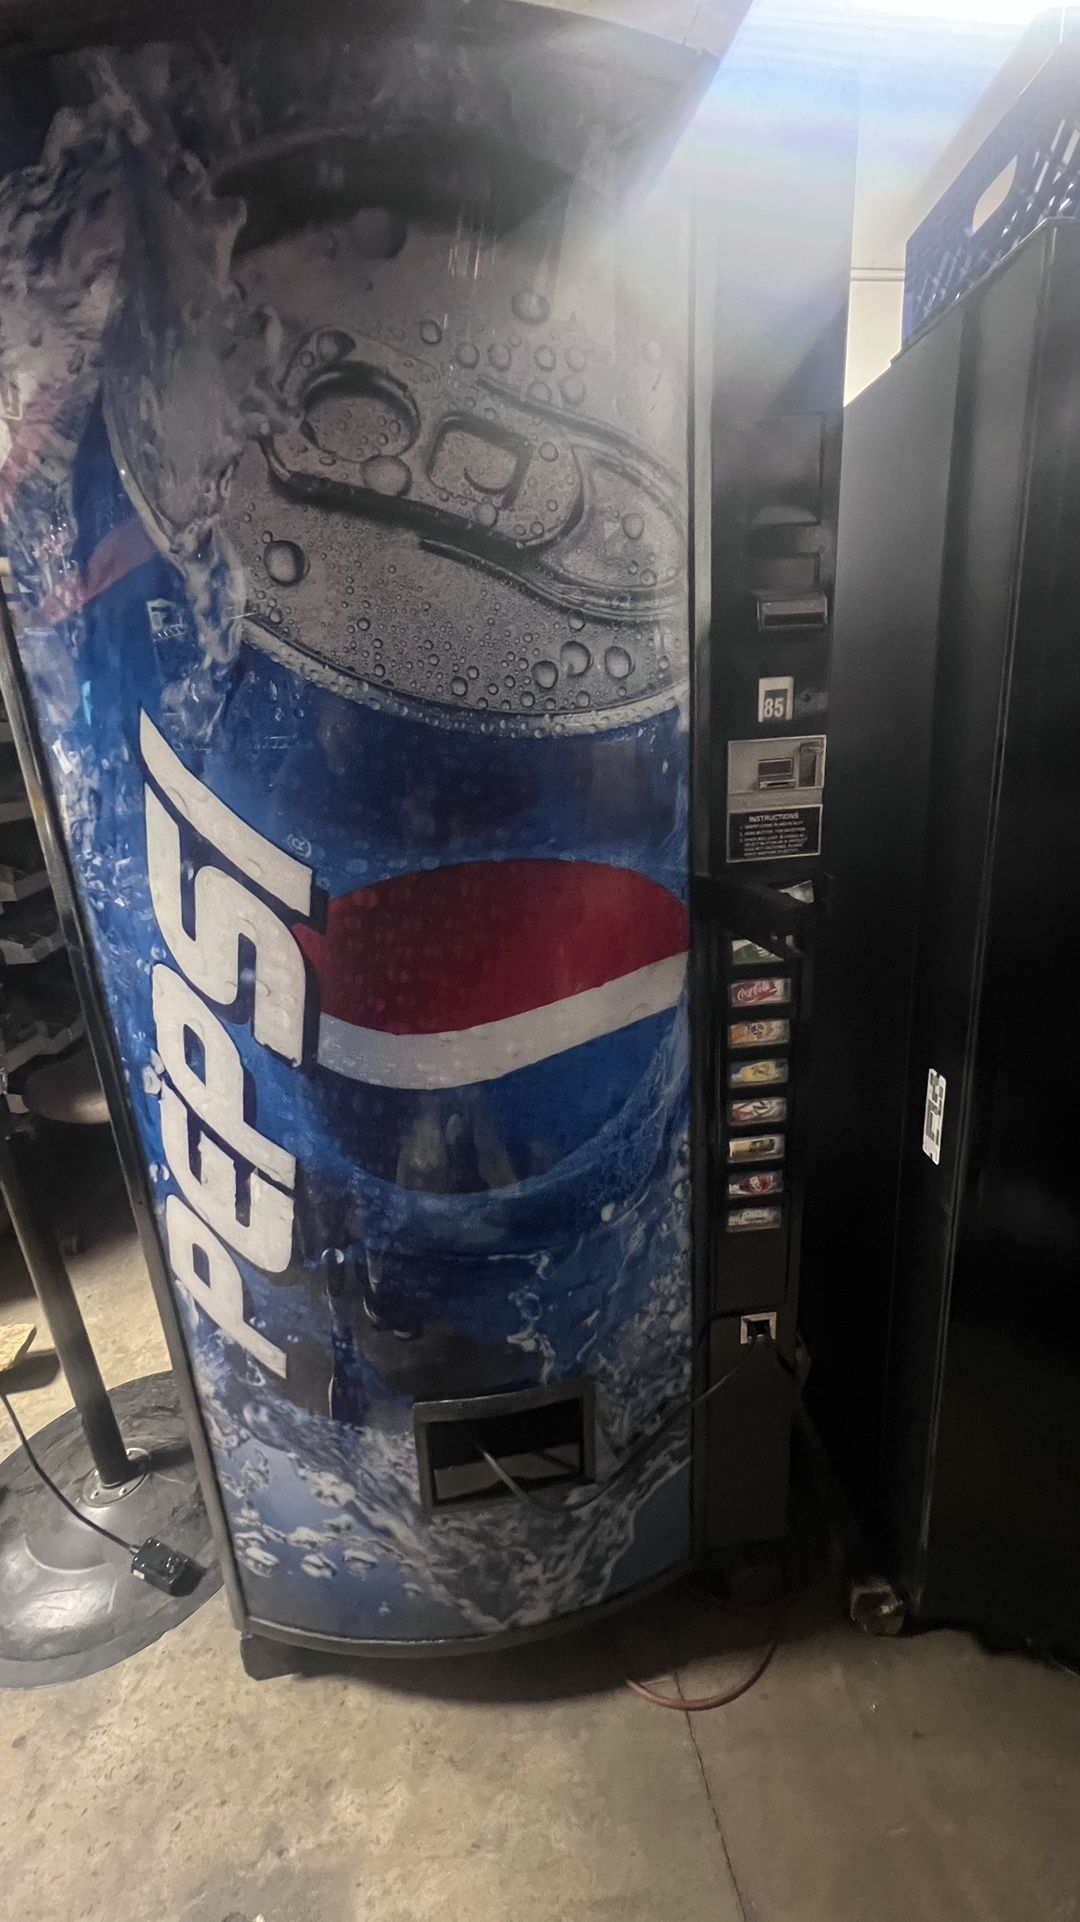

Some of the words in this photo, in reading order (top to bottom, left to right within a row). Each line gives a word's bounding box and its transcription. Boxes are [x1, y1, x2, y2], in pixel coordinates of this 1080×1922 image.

[764, 697, 784, 718] 85
[748, 812, 799, 823] INSTRUCTIONS
[140, 708, 312, 1379] PEPSI
